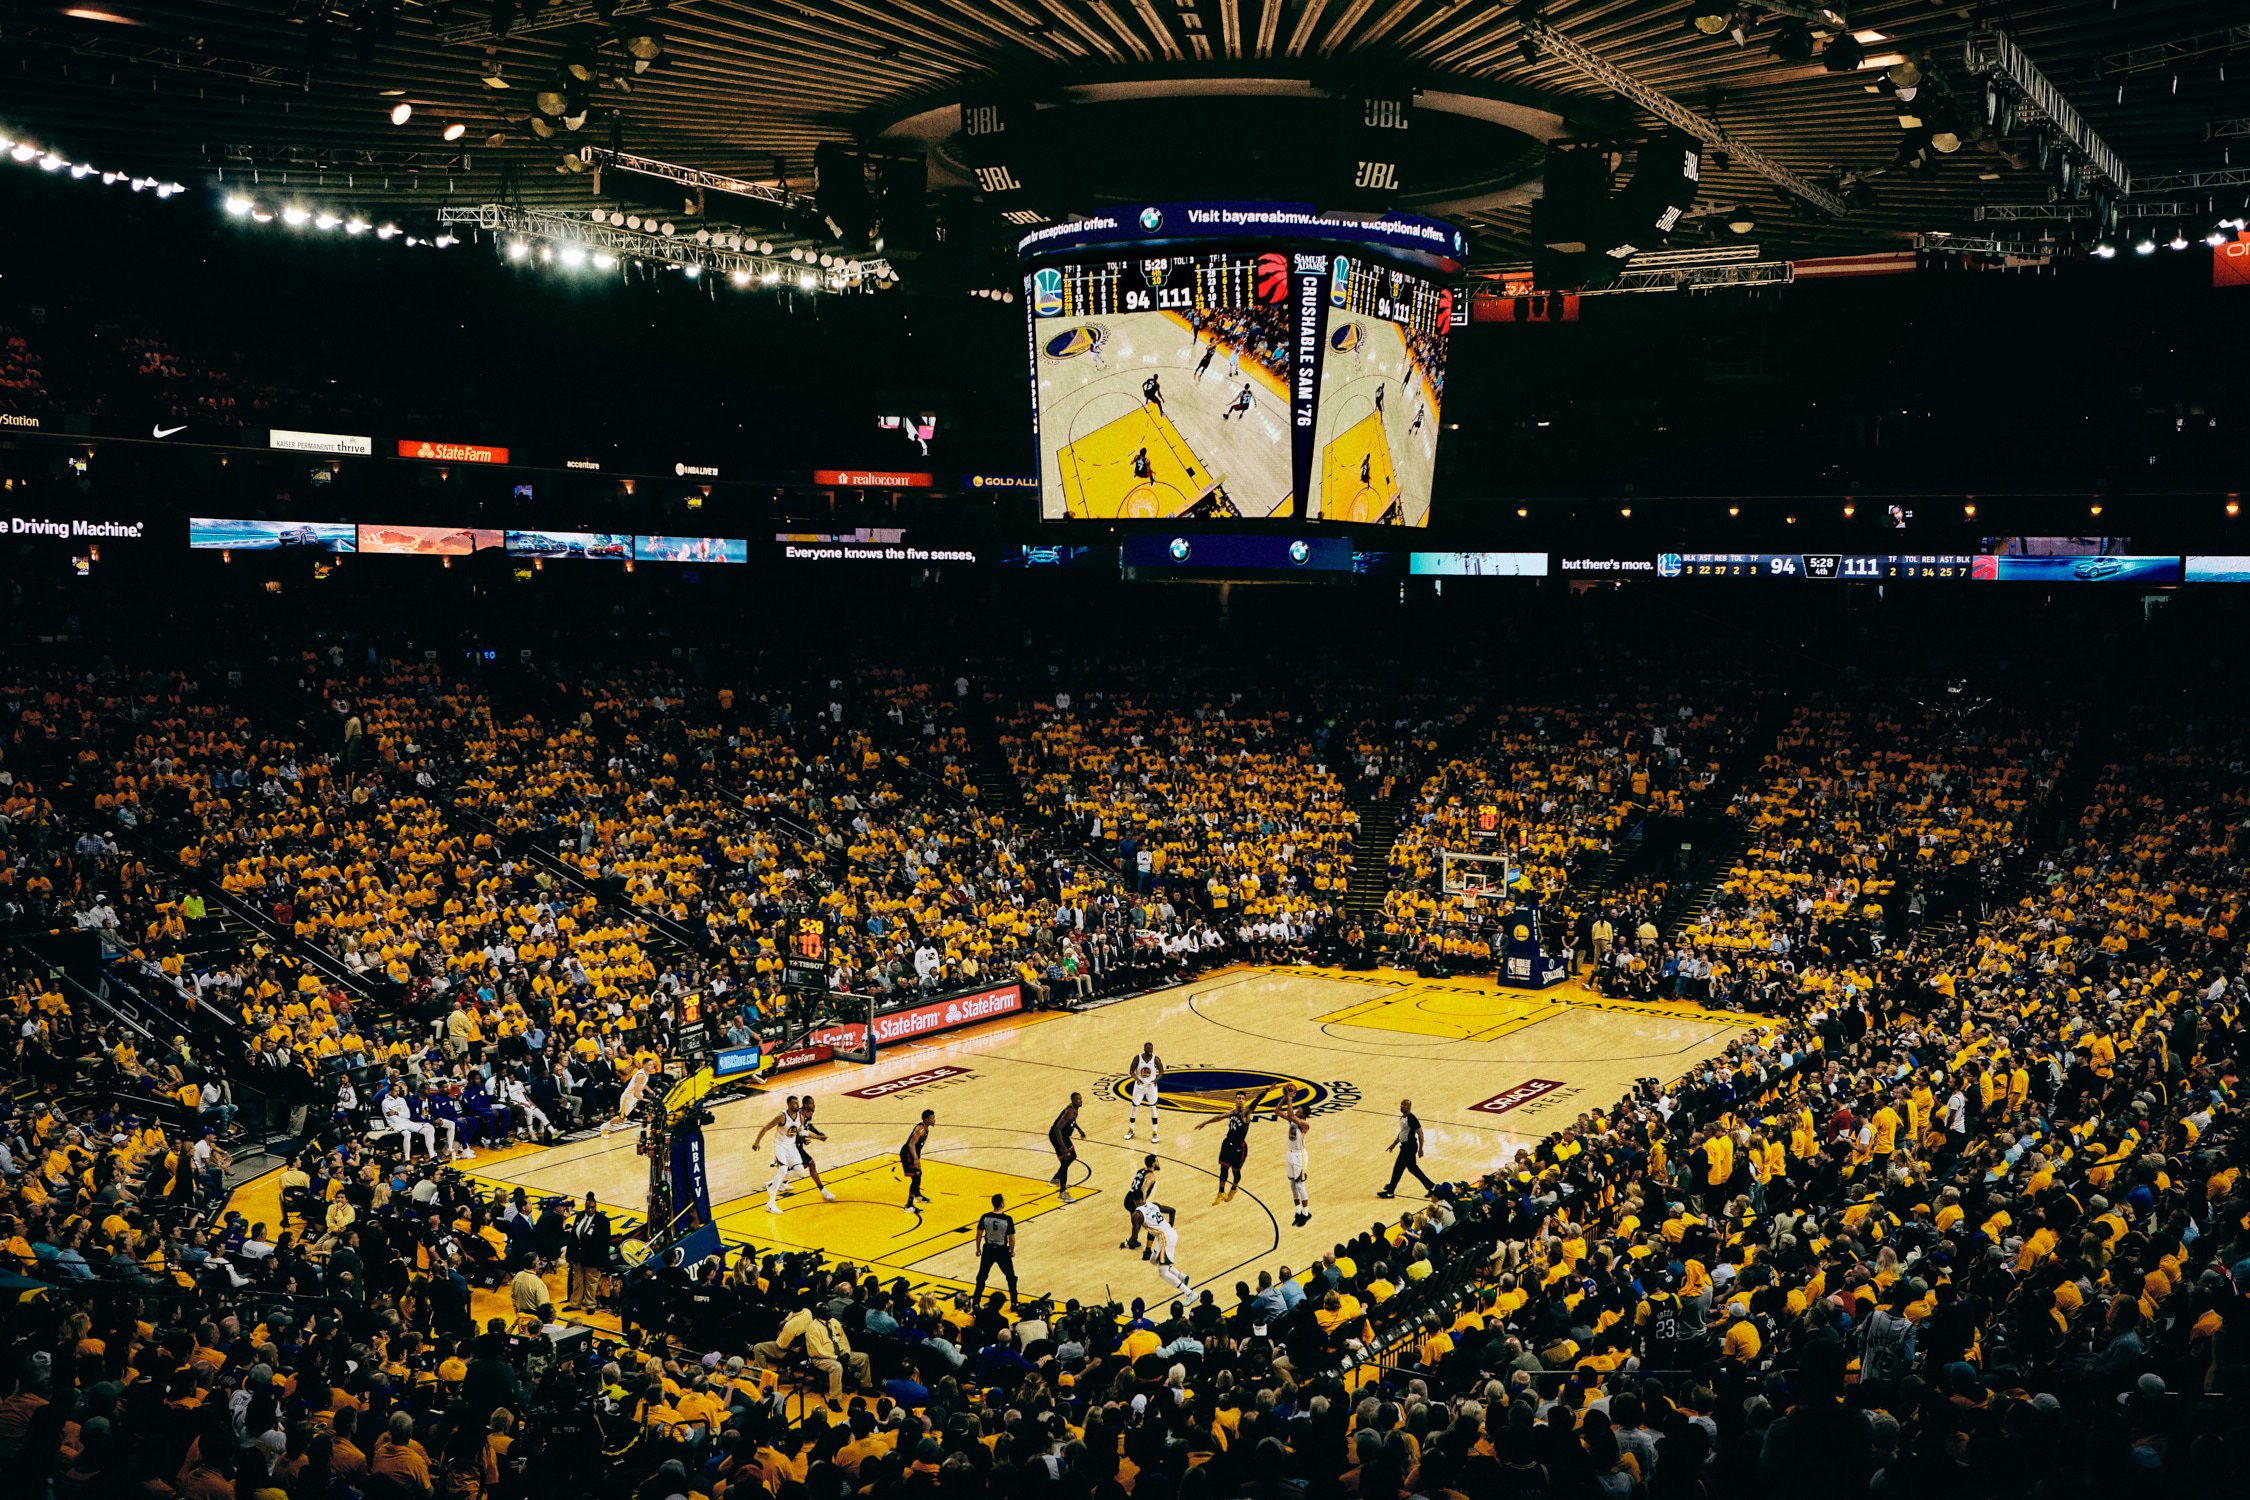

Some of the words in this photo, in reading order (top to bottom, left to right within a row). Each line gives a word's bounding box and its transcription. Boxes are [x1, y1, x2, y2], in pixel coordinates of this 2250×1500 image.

[966, 105, 1005, 135] JBL
[1364, 98, 1408, 129] JBL
[1355, 161, 1399, 190] JBL
[1683, 149, 1699, 182] JBL
[975, 165, 1021, 193] JBL
[1001, 209, 1051, 225] JBL
[1188, 209, 1219, 223] Visit
[1361, 218, 1421, 236] exceptional
[1421, 226, 1446, 243] offers.
[1039, 219, 1083, 239] exceptional
[1083, 216, 1118, 231] offers.
[1144, 259, 1168, 272] 5:28
[1294, 253, 1328, 266] SAMUEL
[1296, 262, 1326, 273] ADAMS
[1152, 277, 1162, 285] 10
[1126, 290, 1151, 310] 94
[1159, 287, 1192, 308] 111
[1378, 298, 1391, 318] 94
[1394, 302, 1410, 324] 111
[1300, 276, 1318, 364] CRUSHABLE
[1298, 367, 1314, 400] SAM
[276, 440, 296, 448] KAISER
[297, 441, 335, 452] PERMANENTE
[337, 442, 366, 454] thrive
[435, 444, 492, 462] StateFarm
[567, 460, 600, 471] accenture
[852, 473, 910, 486] realtor.com
[985, 477, 1013, 487] GOLD
[12, 518, 70, 538] Driving
[785, 546, 842, 561] Everyone
[844, 547, 884, 560] knows
[885, 548, 907, 560] the
[909, 547, 929, 560] five
[930, 549, 976, 563] senses,
[1562, 559, 1581, 570] but
[1582, 558, 1621, 570] there's
[1621, 559, 1654, 570] more.
[1684, 554, 1696, 562] BLK
[1699, 554, 1712, 562] AST
[1809, 558, 1834, 568] 5:28
[1686, 566, 1692, 574] 3
[1699, 566, 1710, 575] 22
[1714, 567, 1726, 575] 37
[1733, 566, 1740, 574] 2
[1750, 566, 1756, 574] 3
[1770, 558, 1796, 575] 94
[1814, 568, 1828, 576] 4th
[1844, 558, 1880, 576] 111
[1890, 567, 1896, 576] 2
[1908, 568, 1915, 576] 3
[1922, 568, 1934, 576] 34
[1940, 568, 1952, 576] 25
[1960, 568, 1966, 576] 7
[1478, 804, 1497, 815] 5:28
[799, 918, 824, 935] 5:28
[800, 934, 822, 958] 10
[799, 961, 825, 970] TISSOT
[962, 993, 1015, 1019] StateFarm
[1269, 968, 1414, 987] GOLDEN
[1425, 984, 1536, 1000] STATE
[1550, 998, 1757, 1025] WARRIORS
[880, 1011, 939, 1040] StateFarm
[786, 1052, 816, 1067] StateFarm
[861, 1068, 958, 1096] ORACLE
[894, 1074, 986, 1101] ARENA
[1092, 1072, 1131, 1102] GOLDEN
[1483, 1082, 1553, 1110] ORACLE
[1520, 1087, 1587, 1115] ARENA
[691, 1140, 701, 1173] NBA
[694, 1177, 702, 1198] TV
[993, 1220, 998, 1230] 6
[1657, 1310, 1674, 1320] GREEN
[1656, 1318, 1675, 1340] 23
